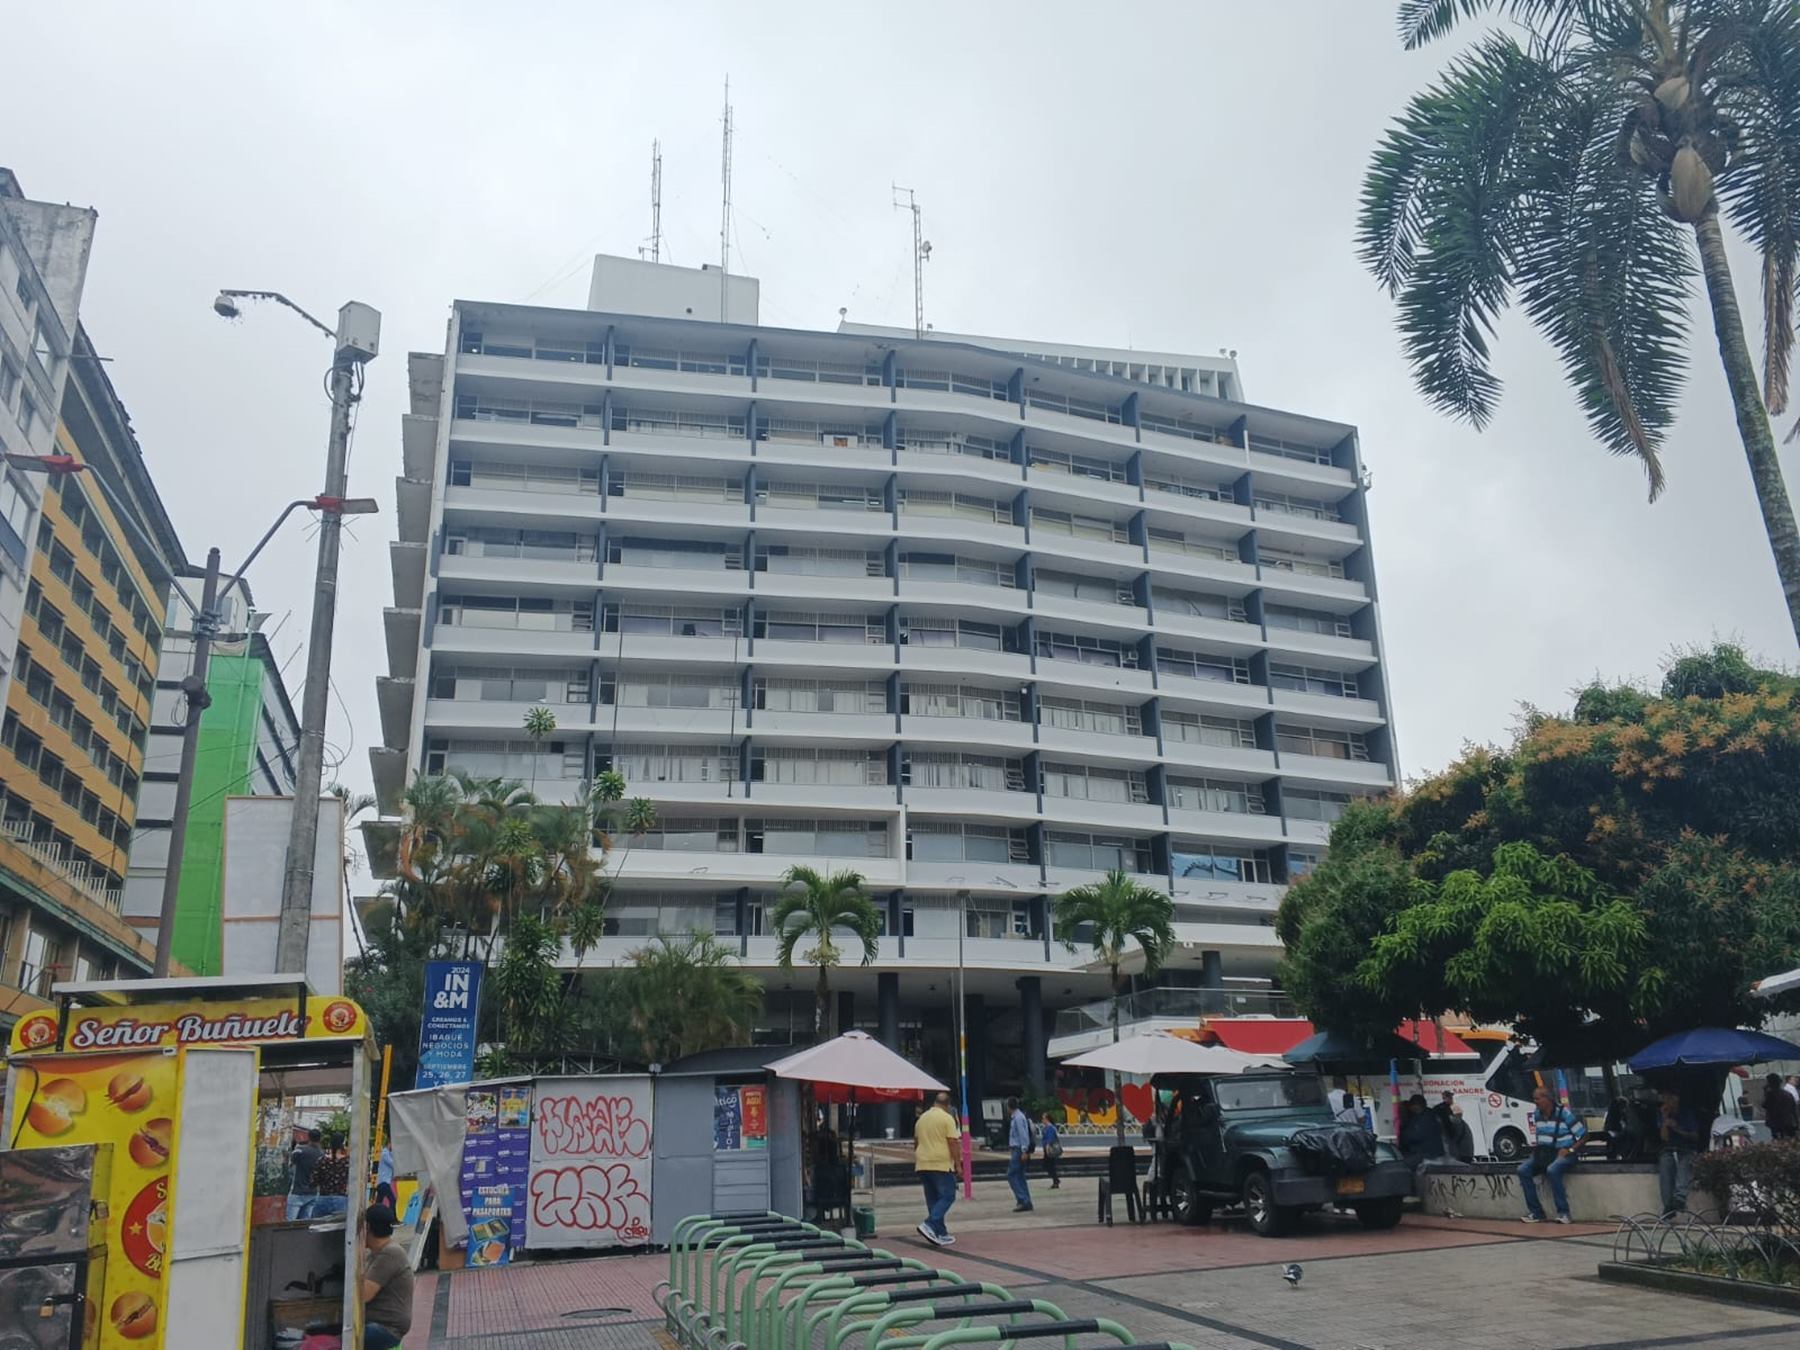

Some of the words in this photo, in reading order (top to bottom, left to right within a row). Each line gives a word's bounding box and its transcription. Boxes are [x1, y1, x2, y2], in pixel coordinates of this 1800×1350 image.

[444, 974, 469, 991] IN
[433, 991, 468, 1009] &M
[73, 1018, 168, 1047] Señor
[422, 1042, 469, 1050] NEGOCIOS
[436, 1050, 463, 1058] MODA
